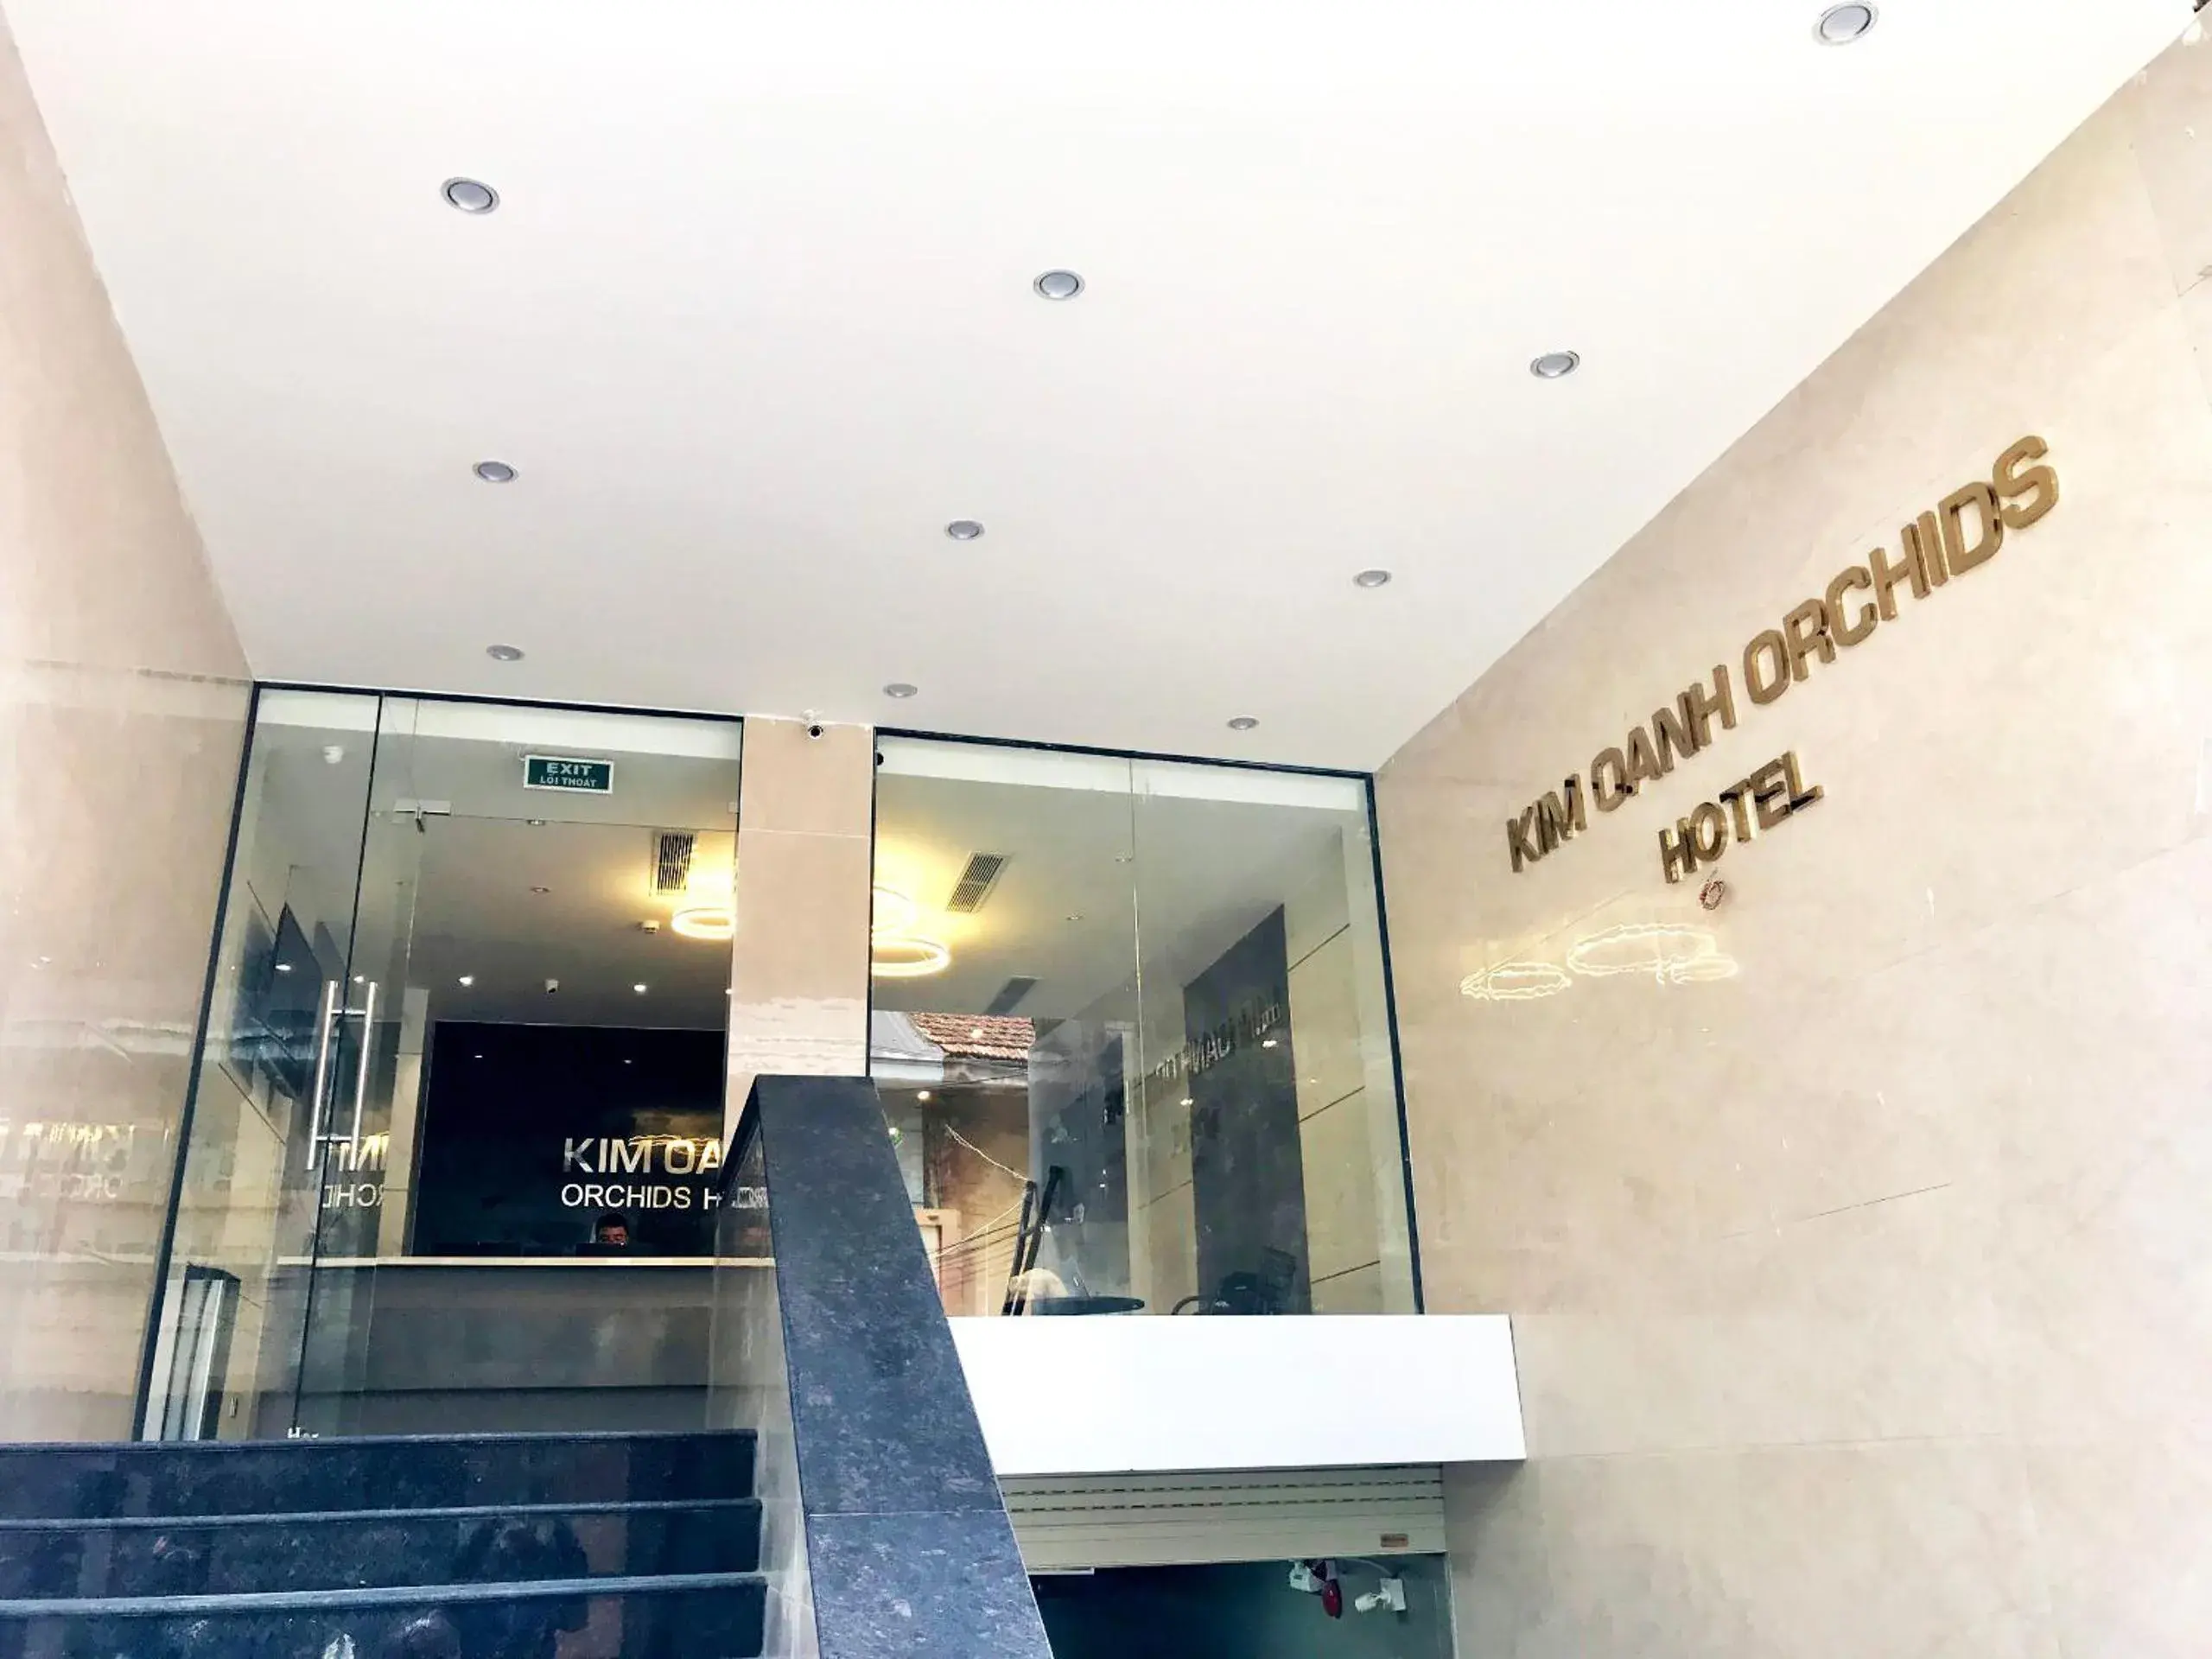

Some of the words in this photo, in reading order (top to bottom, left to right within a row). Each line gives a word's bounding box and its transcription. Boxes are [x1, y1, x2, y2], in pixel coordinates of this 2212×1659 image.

[1506, 772, 1587, 874] KIM
[1590, 664, 1737, 812] OANH
[1743, 435, 2060, 705] ORCHIDS
[546, 762, 593, 776] EXIT
[1658, 750, 1825, 884] HOTEL
[563, 1137, 652, 1173] KIM
[664, 1138, 721, 1175] OA
[562, 1184, 691, 1209] ORCHIDS
